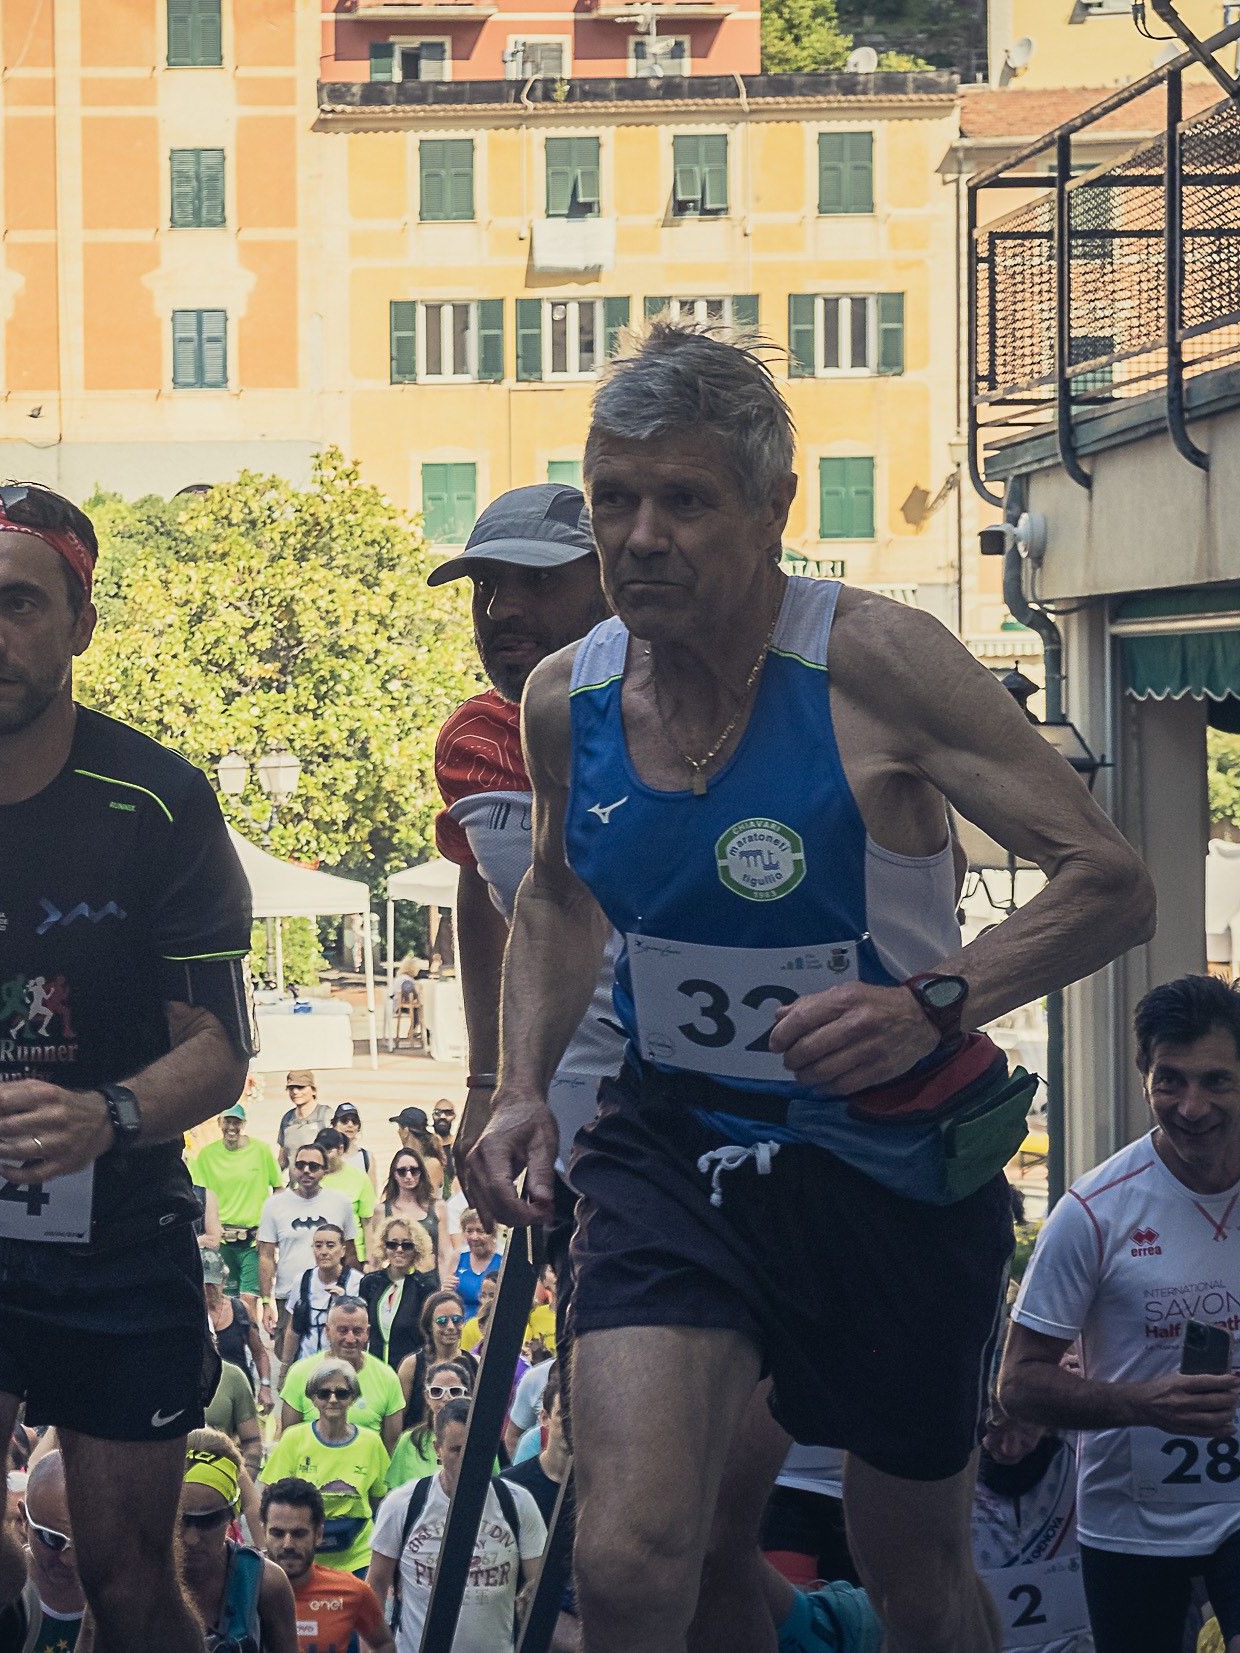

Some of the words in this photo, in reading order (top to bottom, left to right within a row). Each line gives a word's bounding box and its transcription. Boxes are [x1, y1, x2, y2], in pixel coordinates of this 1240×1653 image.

[731, 820, 781, 836] CHIAVARI
[677, 978, 800, 1052] 32
[0, 1038, 79, 1063] Runner
[1130, 1245, 1162, 1258] errea
[1143, 1280, 1227, 1299] INTERNATIONAL
[1144, 1322, 1181, 1339] Half
[1160, 1436, 1240, 1484] 28
[309, 1596, 344, 1612] enel
[1007, 1583, 1048, 1629] 2
